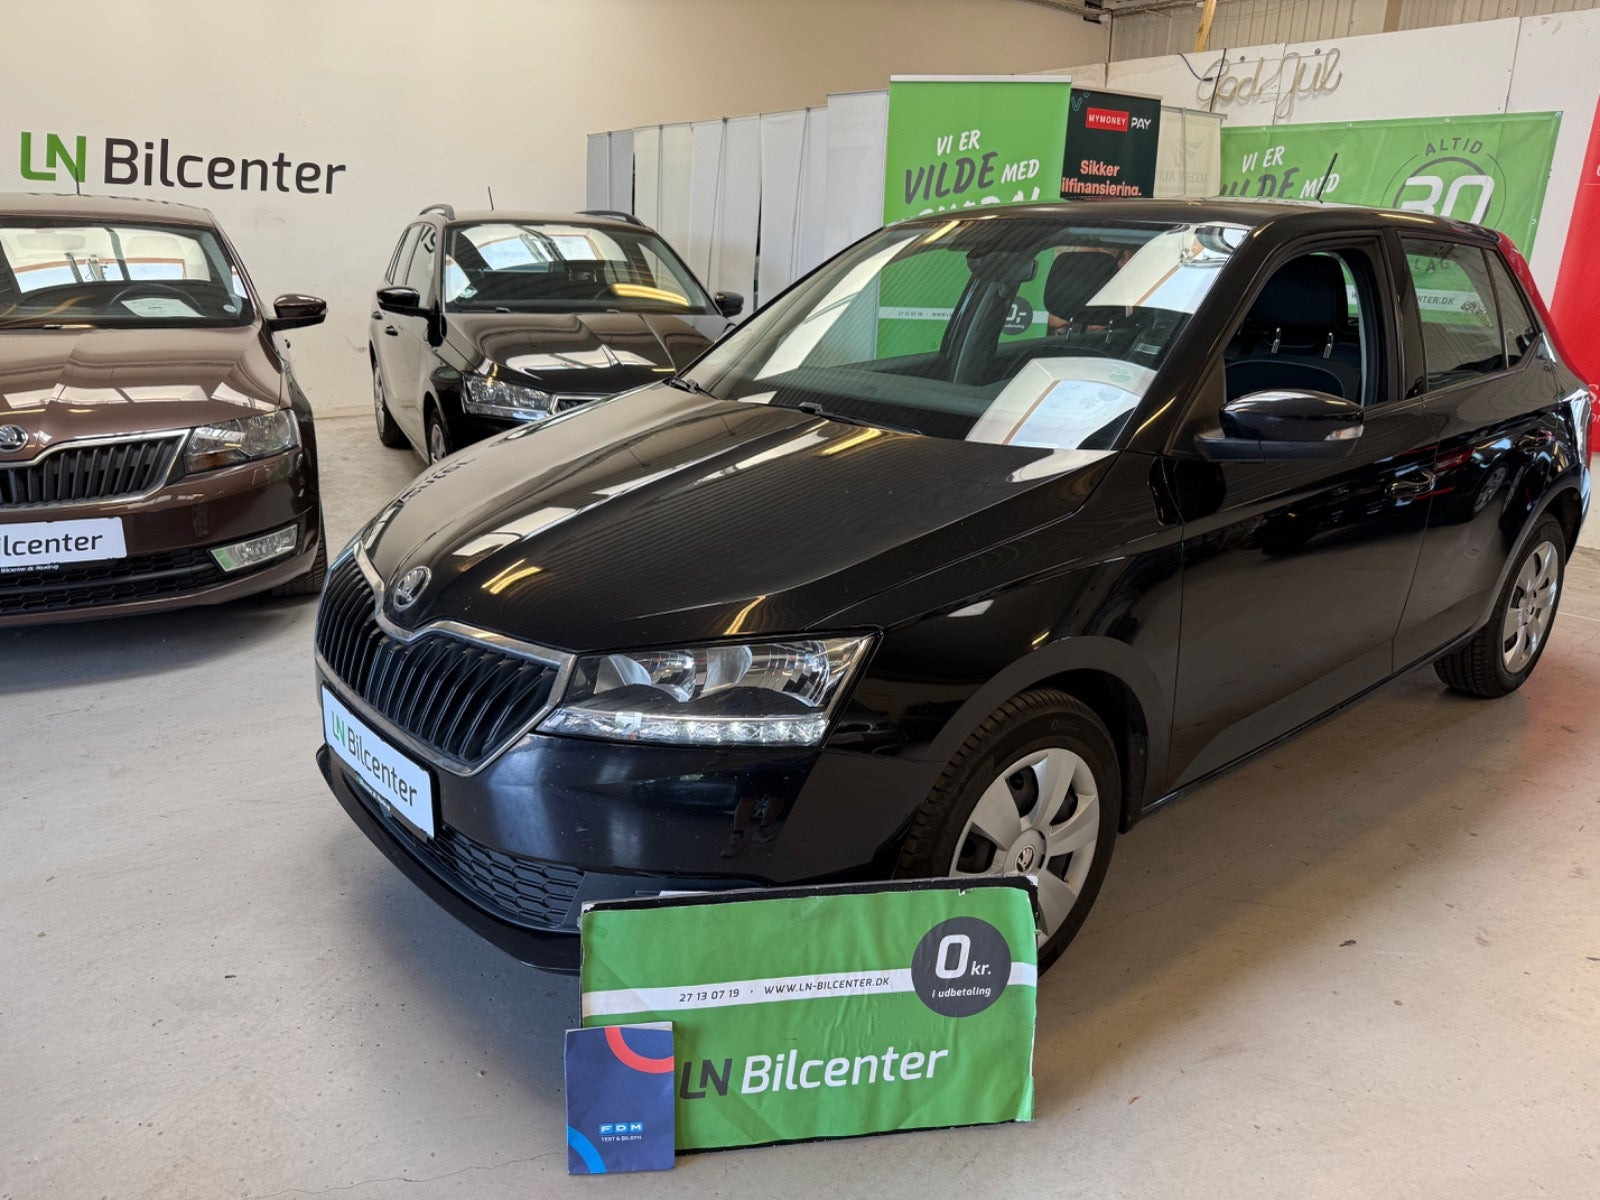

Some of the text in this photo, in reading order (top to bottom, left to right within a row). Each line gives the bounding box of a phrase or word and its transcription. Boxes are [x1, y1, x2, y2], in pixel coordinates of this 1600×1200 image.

[1088, 114, 1152, 130] MYMONEY PAY
[936, 129, 981, 157] VI ER
[1425, 137, 1483, 157] ALTID
[20, 131, 346, 195] LN Bilcenter
[1079, 159, 1120, 177] Sikker
[1242, 145, 1285, 174] VI ER
[904, 151, 999, 206] VILDE
[1001, 158, 1040, 184] MED
[1061, 177, 1142, 196] ilfinansiering.
[2, 533, 103, 556] lcenter
[331, 710, 346, 748] LN
[347, 726, 417, 808] Bilcenter
[935, 933, 992, 980] 0 kr.
[679, 976, 891, 1003] 27 13 07 19 WWW.LN-BILCENTER.DK
[938, 987, 992, 998] udbetaling
[679, 1045, 949, 1101] LN Bilcenter
[601, 1123, 643, 1133] FDM
